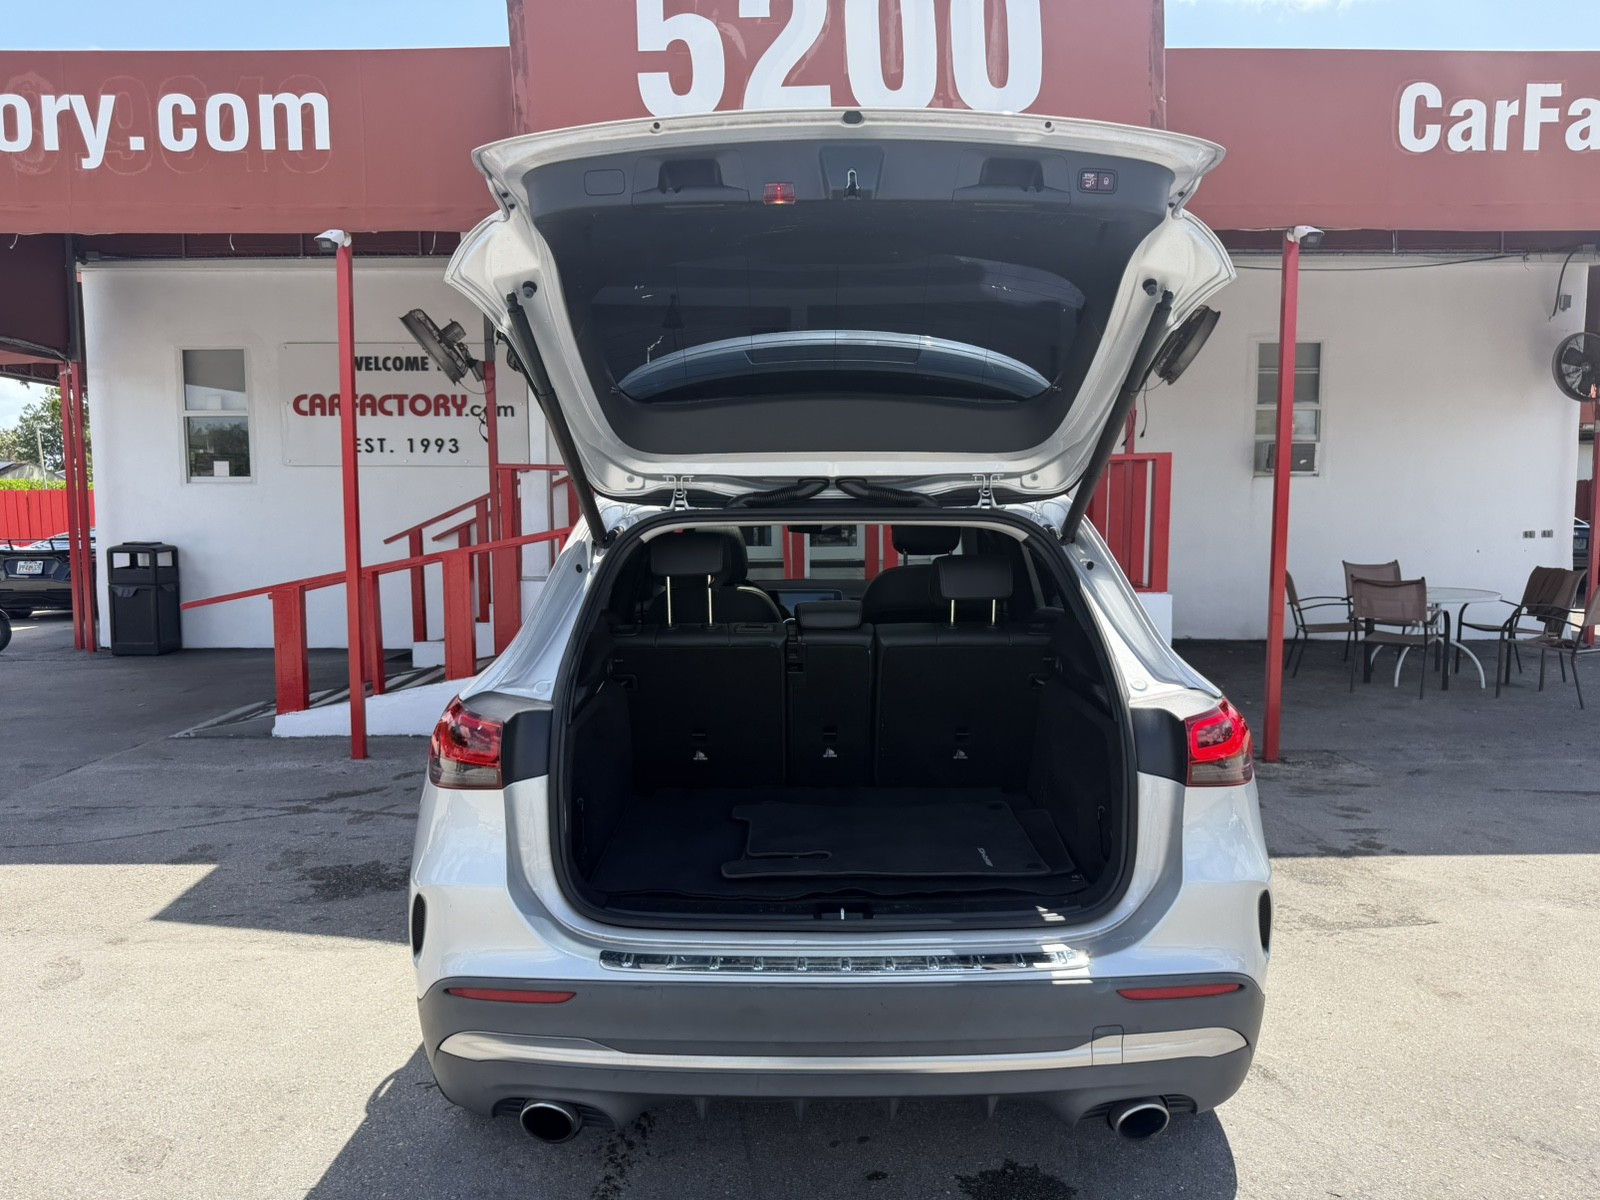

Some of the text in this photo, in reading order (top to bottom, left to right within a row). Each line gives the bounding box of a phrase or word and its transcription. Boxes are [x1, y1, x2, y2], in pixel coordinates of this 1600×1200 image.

[636, 0, 1043, 117] 5200
[1398, 81, 1600, 153] CarFa
[354, 356, 429, 372] WELCOME
[407, 438, 460, 453] 1993
